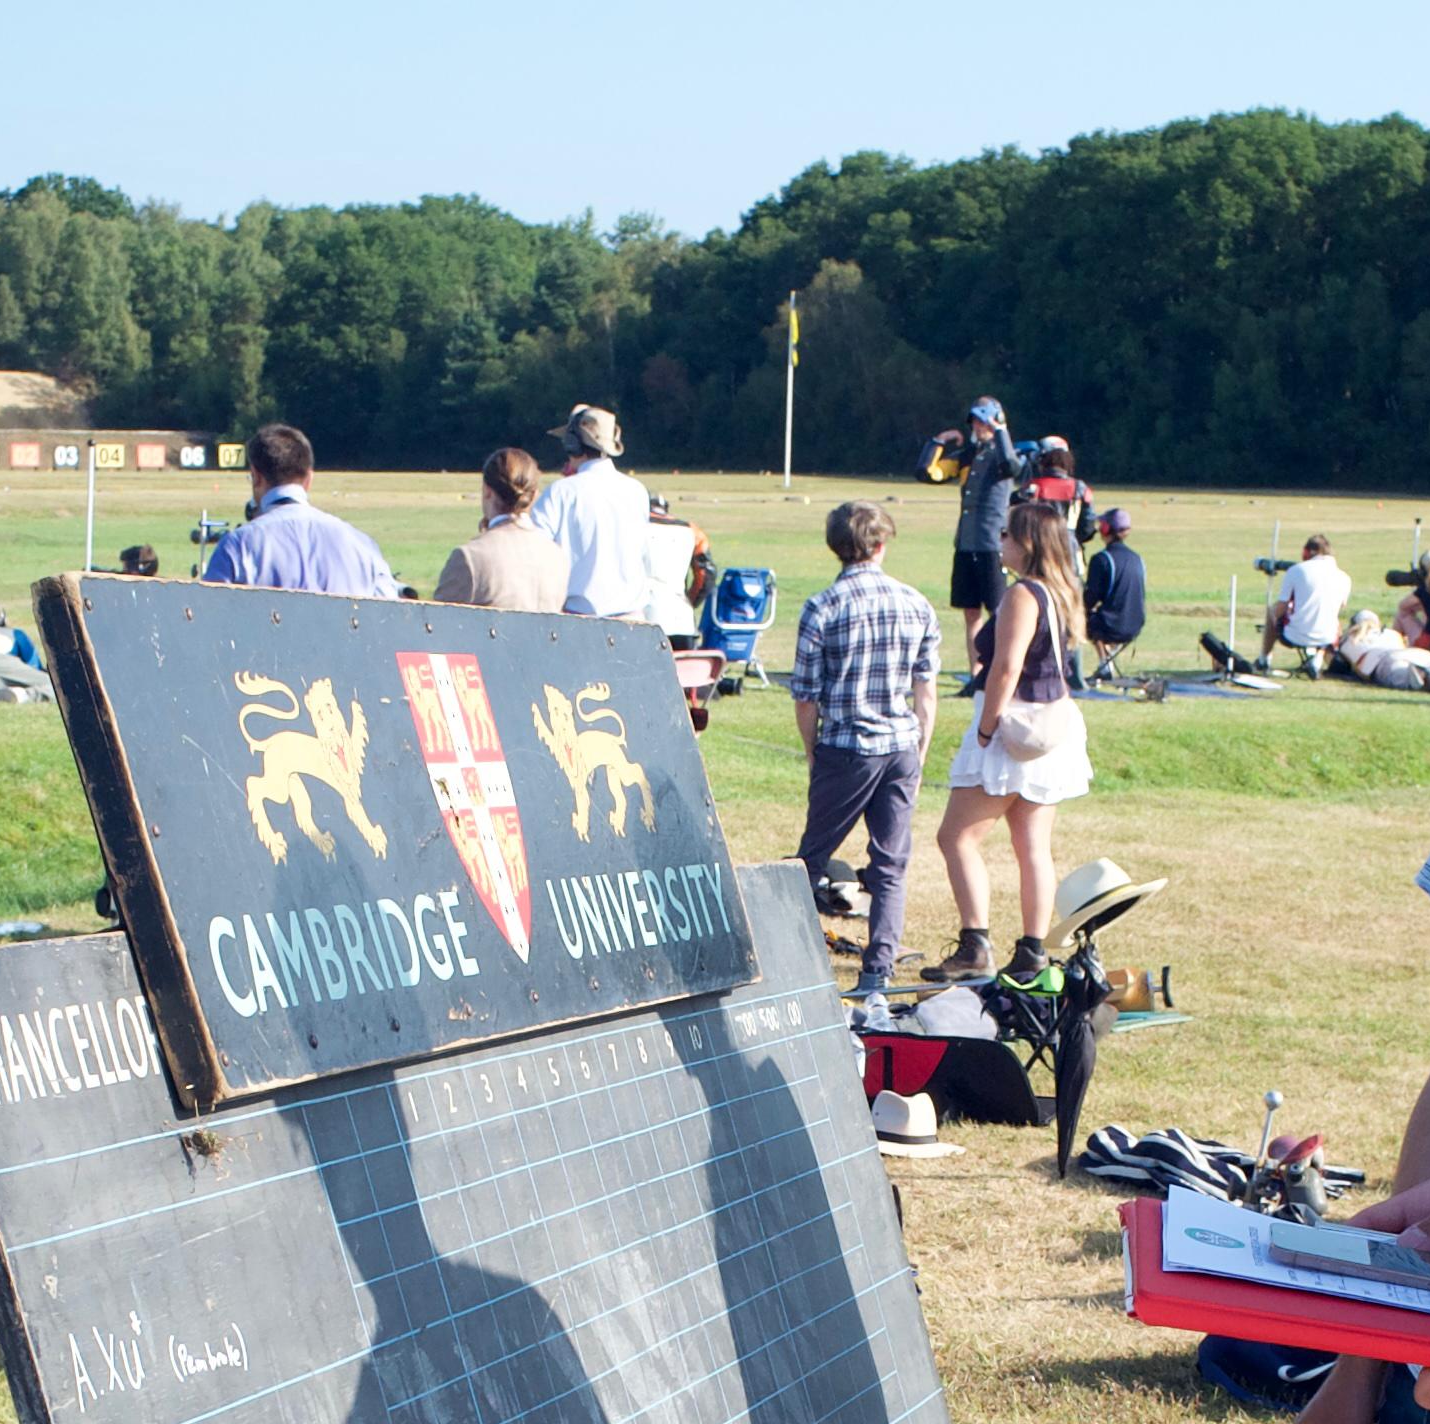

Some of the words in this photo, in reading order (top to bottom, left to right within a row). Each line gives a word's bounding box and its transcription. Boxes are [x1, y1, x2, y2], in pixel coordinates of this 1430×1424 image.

[54, 445, 79, 466] 03
[99, 447, 120, 464] 04
[179, 446, 205, 465] 06
[223, 447, 242, 464] 07
[208, 890, 480, 1018] CAMBRIDGE
[545, 862, 731, 960] UNIVERSITY
[408, 1091, 419, 1122] 1
[443, 1081, 458, 1114] 2
[480, 1073, 494, 1103] 3
[517, 1065, 528, 1094] 4
[547, 1057, 560, 1086] 5
[579, 1049, 592, 1079] 6
[607, 1043, 619, 1071] 7
[637, 1036, 648, 1064] 8
[663, 1030, 675, 1058] 9
[688, 1024, 704, 1051] 10
[168, 1322, 249, 1383] (Pembroke)
